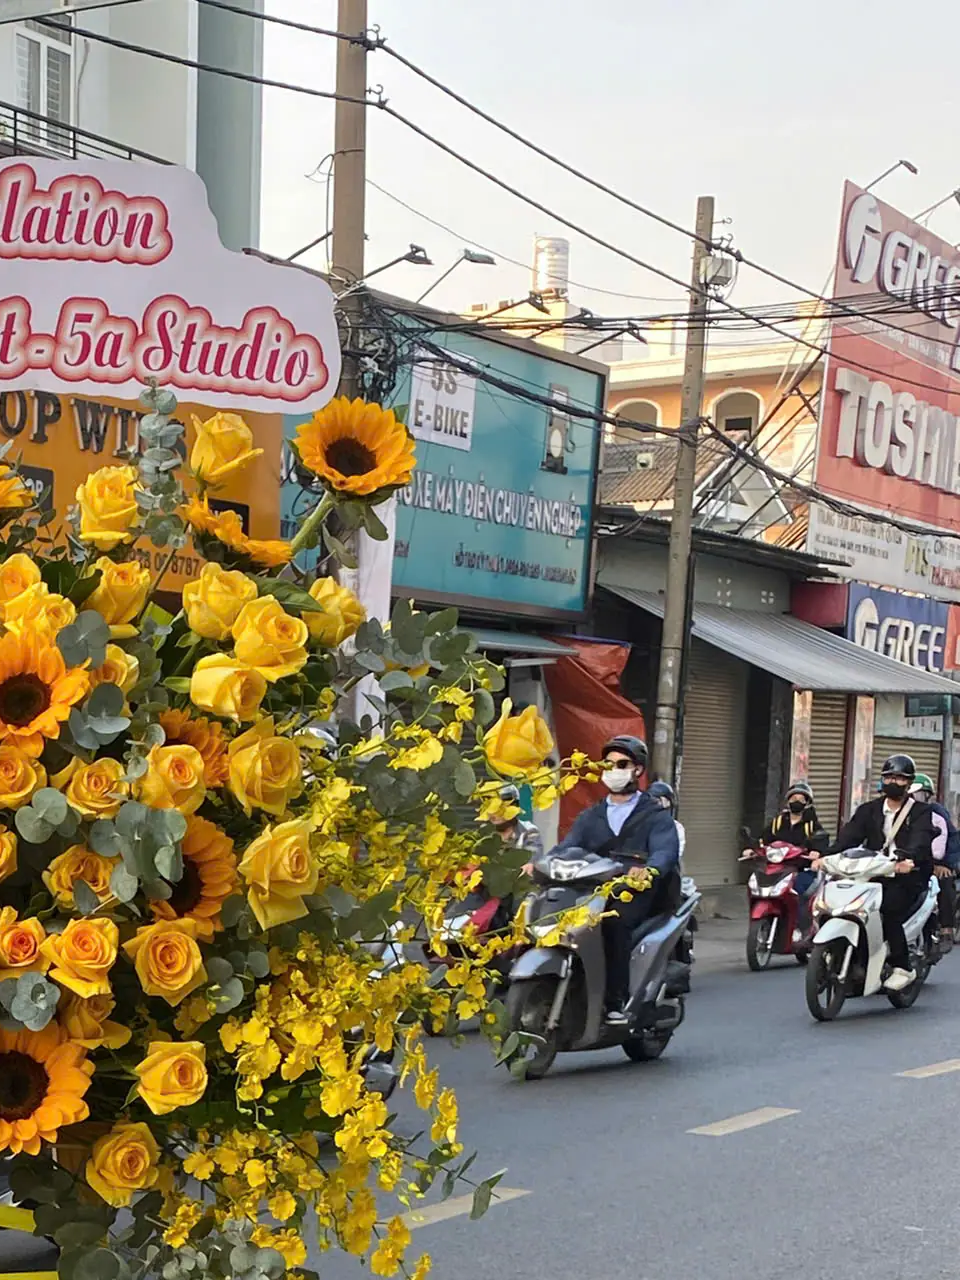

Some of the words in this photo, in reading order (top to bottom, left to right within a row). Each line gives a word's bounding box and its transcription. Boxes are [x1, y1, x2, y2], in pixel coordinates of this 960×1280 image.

[62, 311, 128, 368] 5a
[142, 309, 317, 388] Studio
[414, 471, 433, 510] XE
[878, 616, 944, 673] GREE
